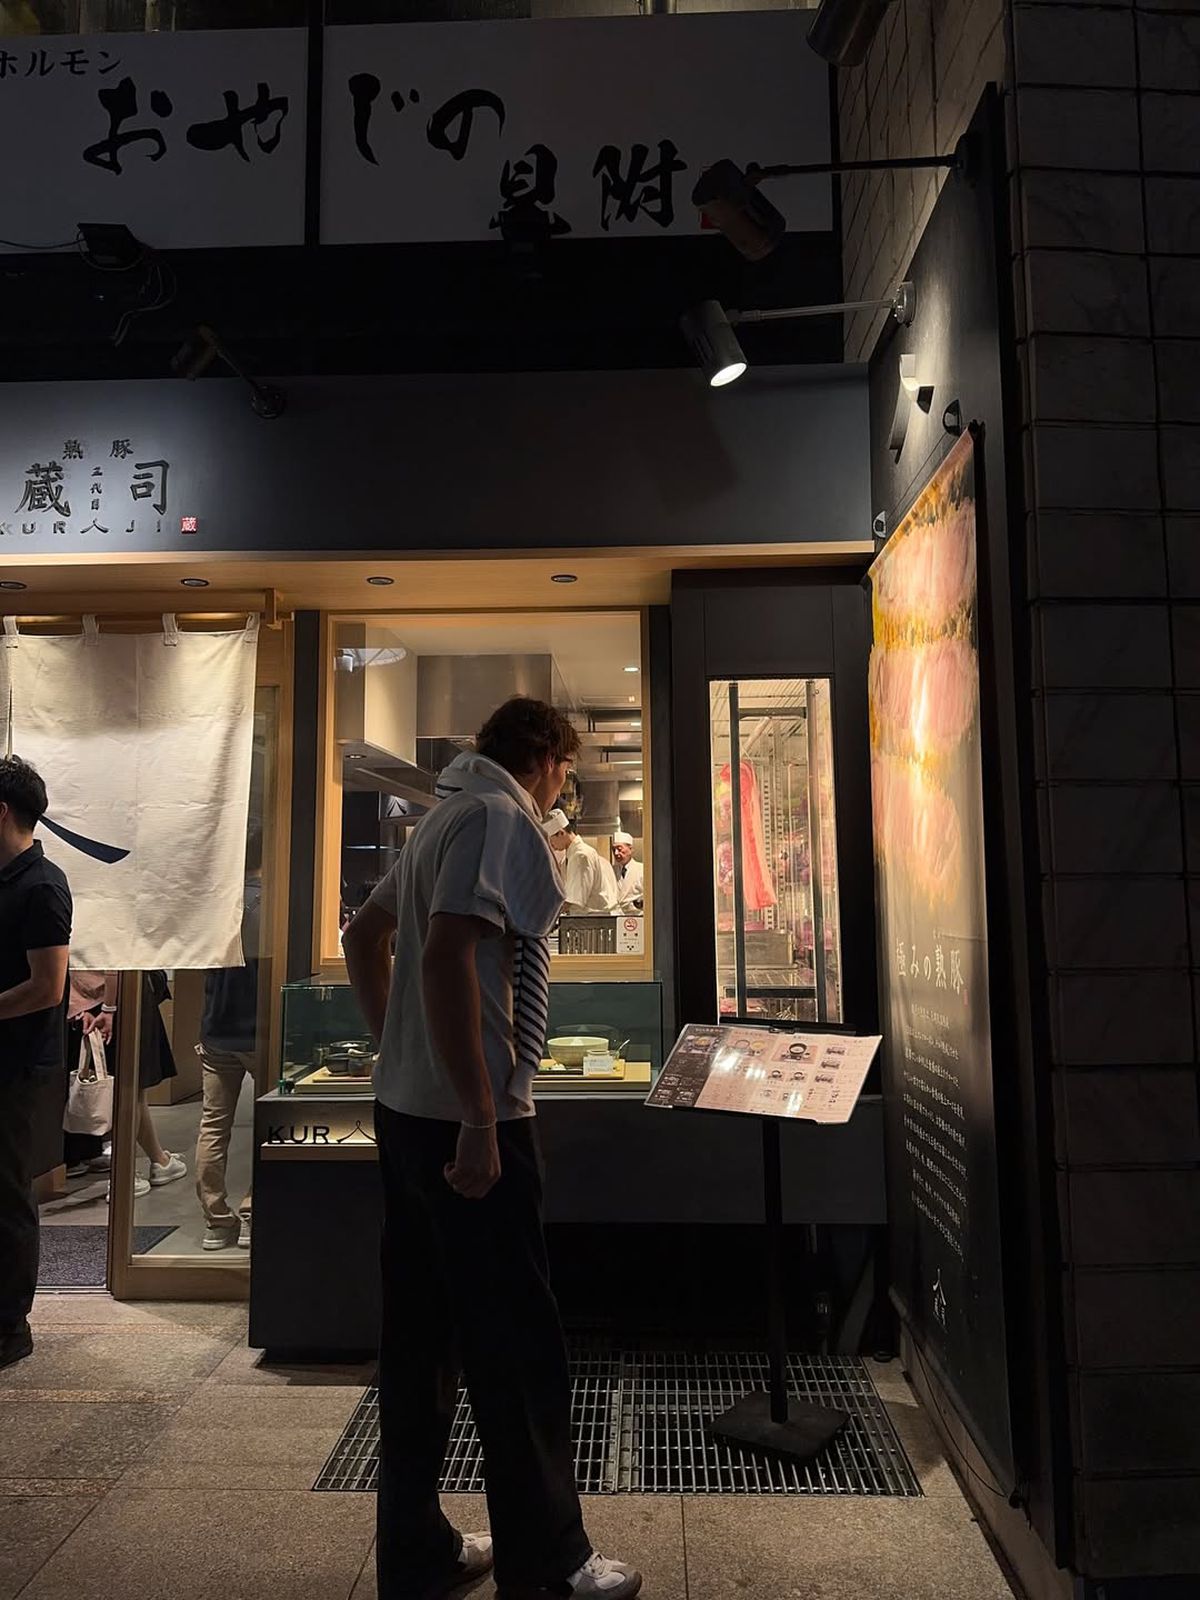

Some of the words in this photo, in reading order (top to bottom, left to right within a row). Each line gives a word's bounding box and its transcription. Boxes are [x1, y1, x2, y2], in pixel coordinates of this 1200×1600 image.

[0, 48, 120, 78] ホルモン
[84, 72, 505, 175] おやじの
